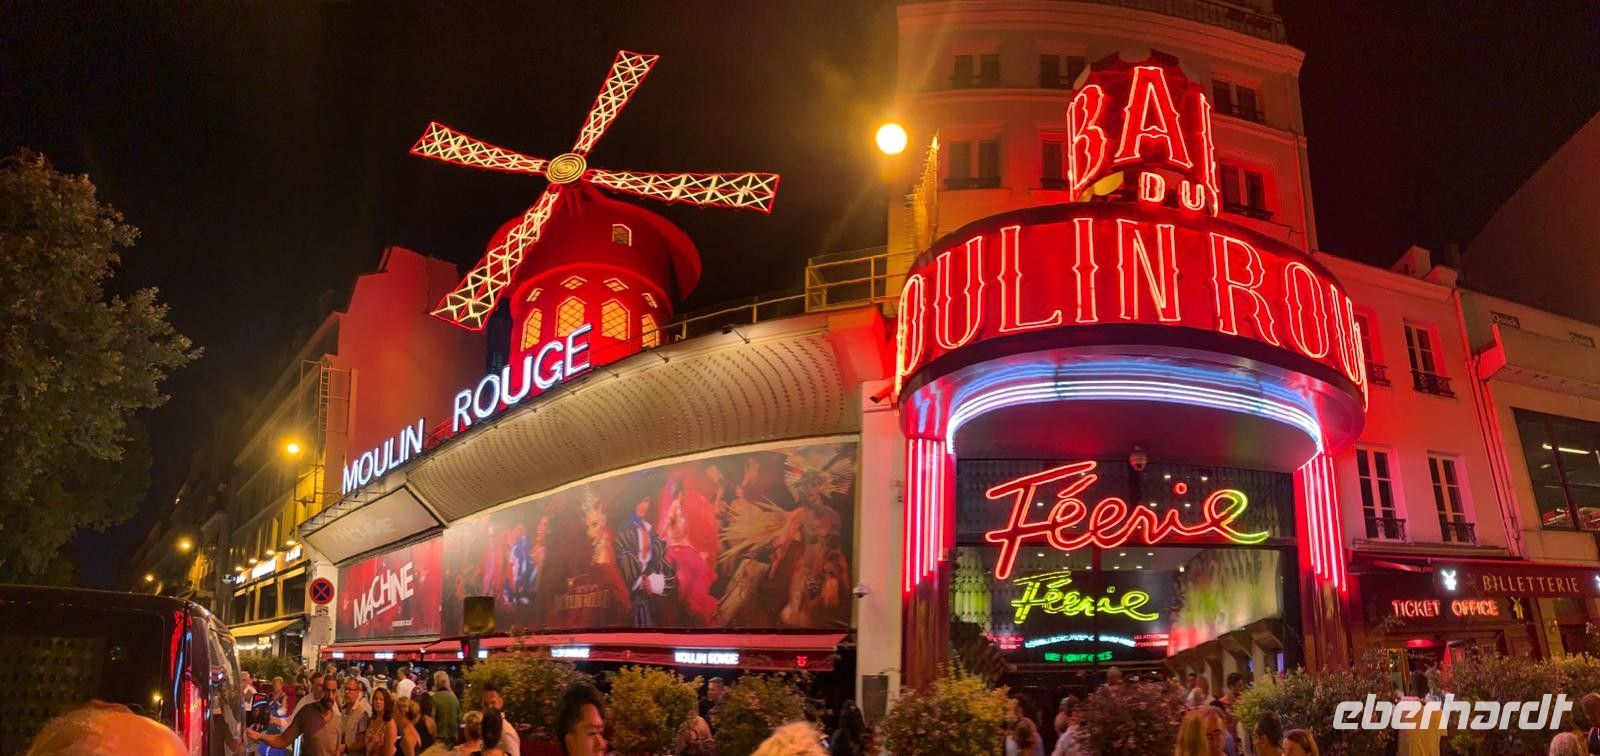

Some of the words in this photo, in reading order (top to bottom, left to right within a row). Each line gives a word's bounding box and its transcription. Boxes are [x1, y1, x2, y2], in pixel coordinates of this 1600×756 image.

[1141, 171, 1206, 211] DU
[896, 216, 1182, 396] OULIN
[342, 417, 425, 496] MOULIN
[452, 322, 592, 433] ROUGE
[985, 460, 1270, 580] Féerie
[353, 561, 415, 629] MACHINE
[1391, 600, 1441, 617] TICKET
[1451, 599, 1500, 616] OFFICE
[1482, 575, 1580, 593] BILLETTERIE
